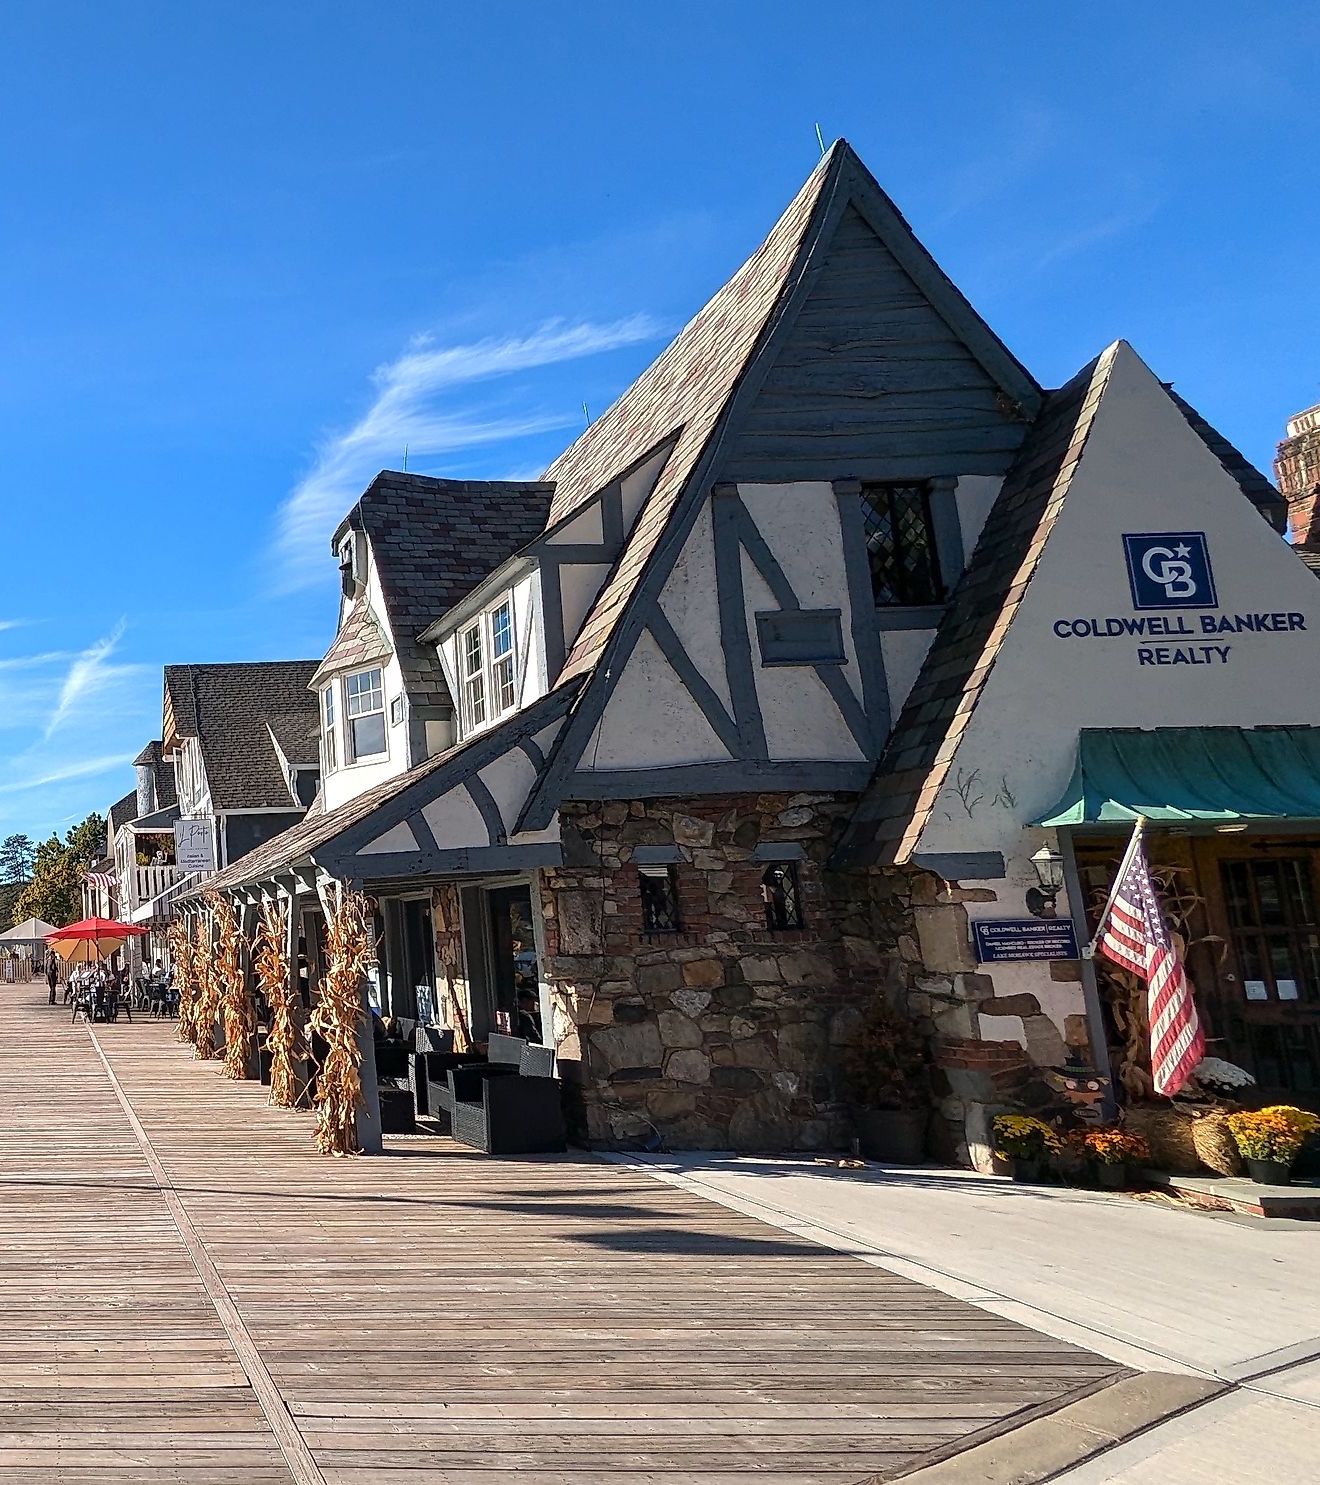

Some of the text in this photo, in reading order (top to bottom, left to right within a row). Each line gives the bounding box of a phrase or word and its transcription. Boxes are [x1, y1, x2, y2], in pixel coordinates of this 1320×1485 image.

[1142, 546, 1197, 598] CB
[1053, 612, 1307, 639] COLDWELL BANKER
[1137, 646, 1232, 666] REALTY
